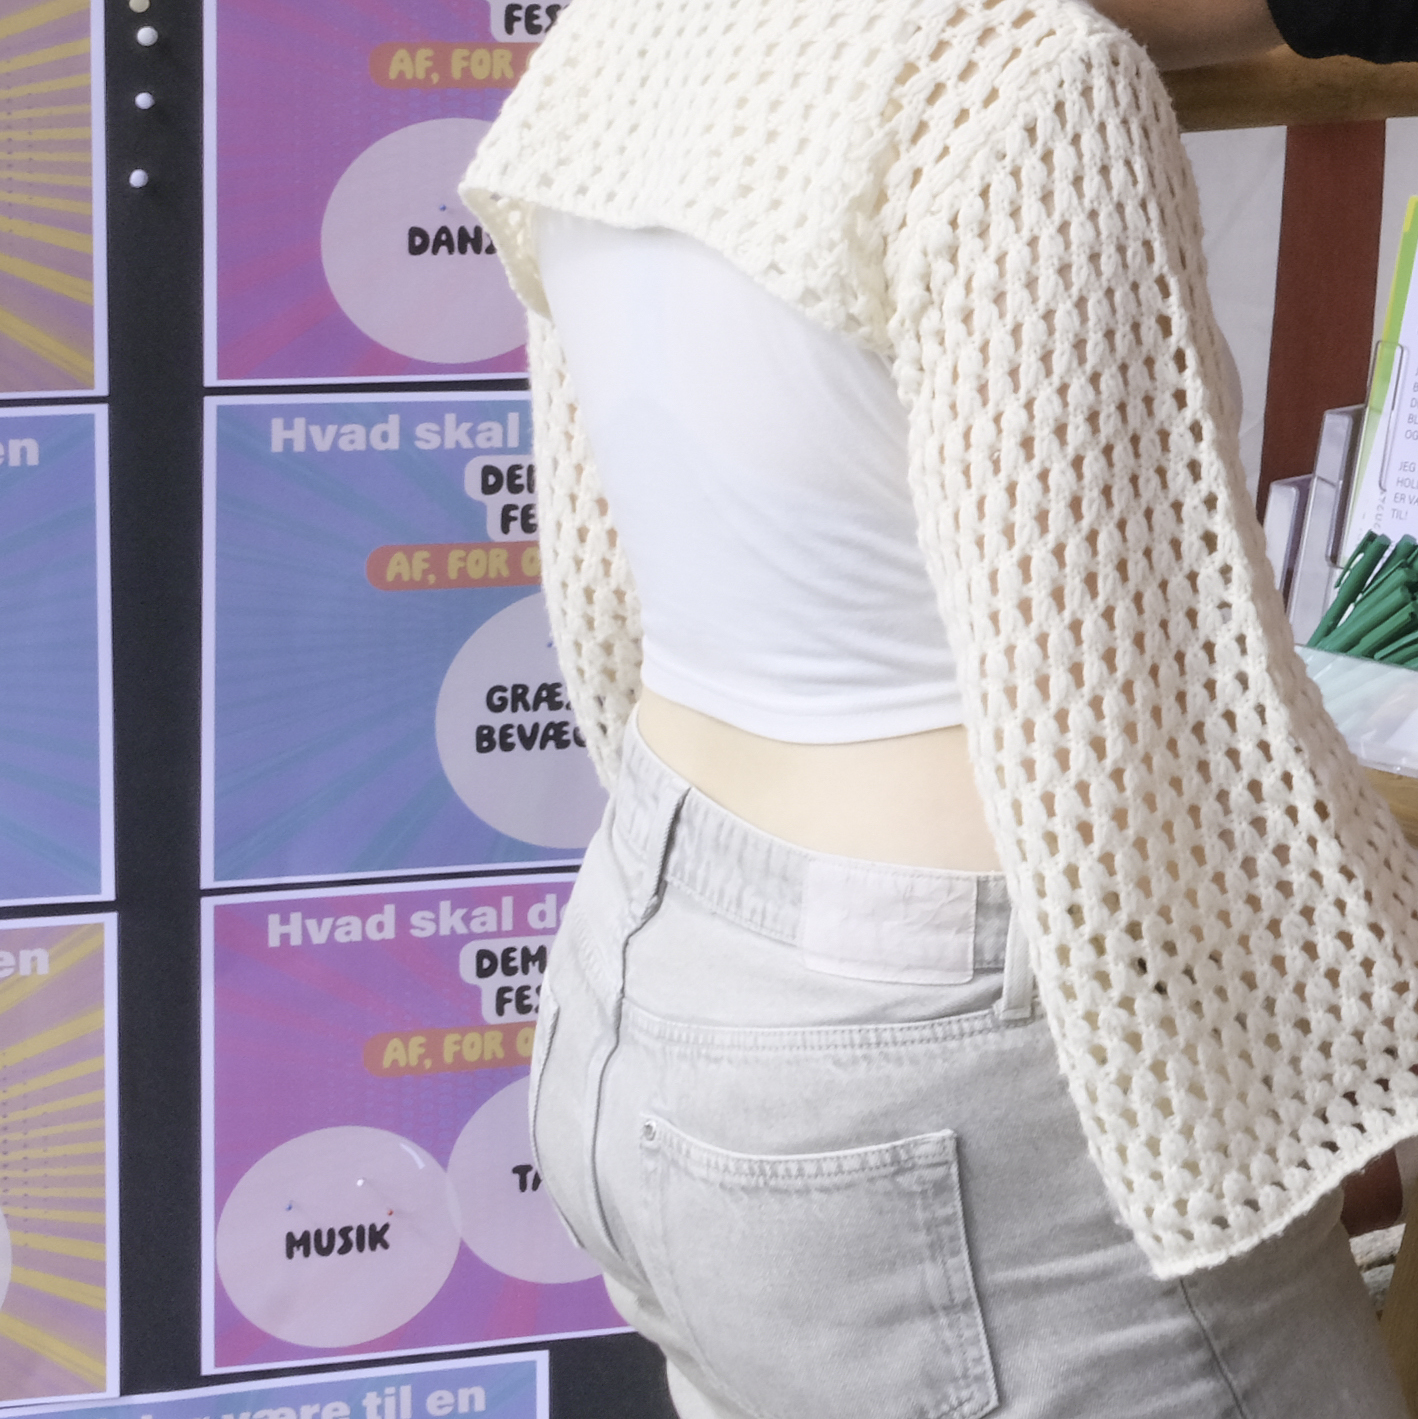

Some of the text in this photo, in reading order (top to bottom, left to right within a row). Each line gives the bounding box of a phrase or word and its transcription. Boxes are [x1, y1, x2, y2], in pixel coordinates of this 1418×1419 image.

[388, 47, 439, 84] AF,
[450, 49, 514, 80] FOR
[271, 412, 519, 453] Hvad skal
[1404, 429, 1418, 441] OG
[1398, 460, 1415, 473] JEG
[1393, 493, 1407, 505] ER
[386, 550, 436, 585] AF,
[447, 548, 510, 580] FOR
[267, 904, 395, 948] Hvad
[410, 896, 513, 938] skal
[382, 1035, 432, 1070] AF,
[443, 1030, 505, 1064] FOR
[285, 1222, 390, 1260] MUSIK
[363, 1385, 412, 1419] til
[426, 1386, 486, 1416] en
